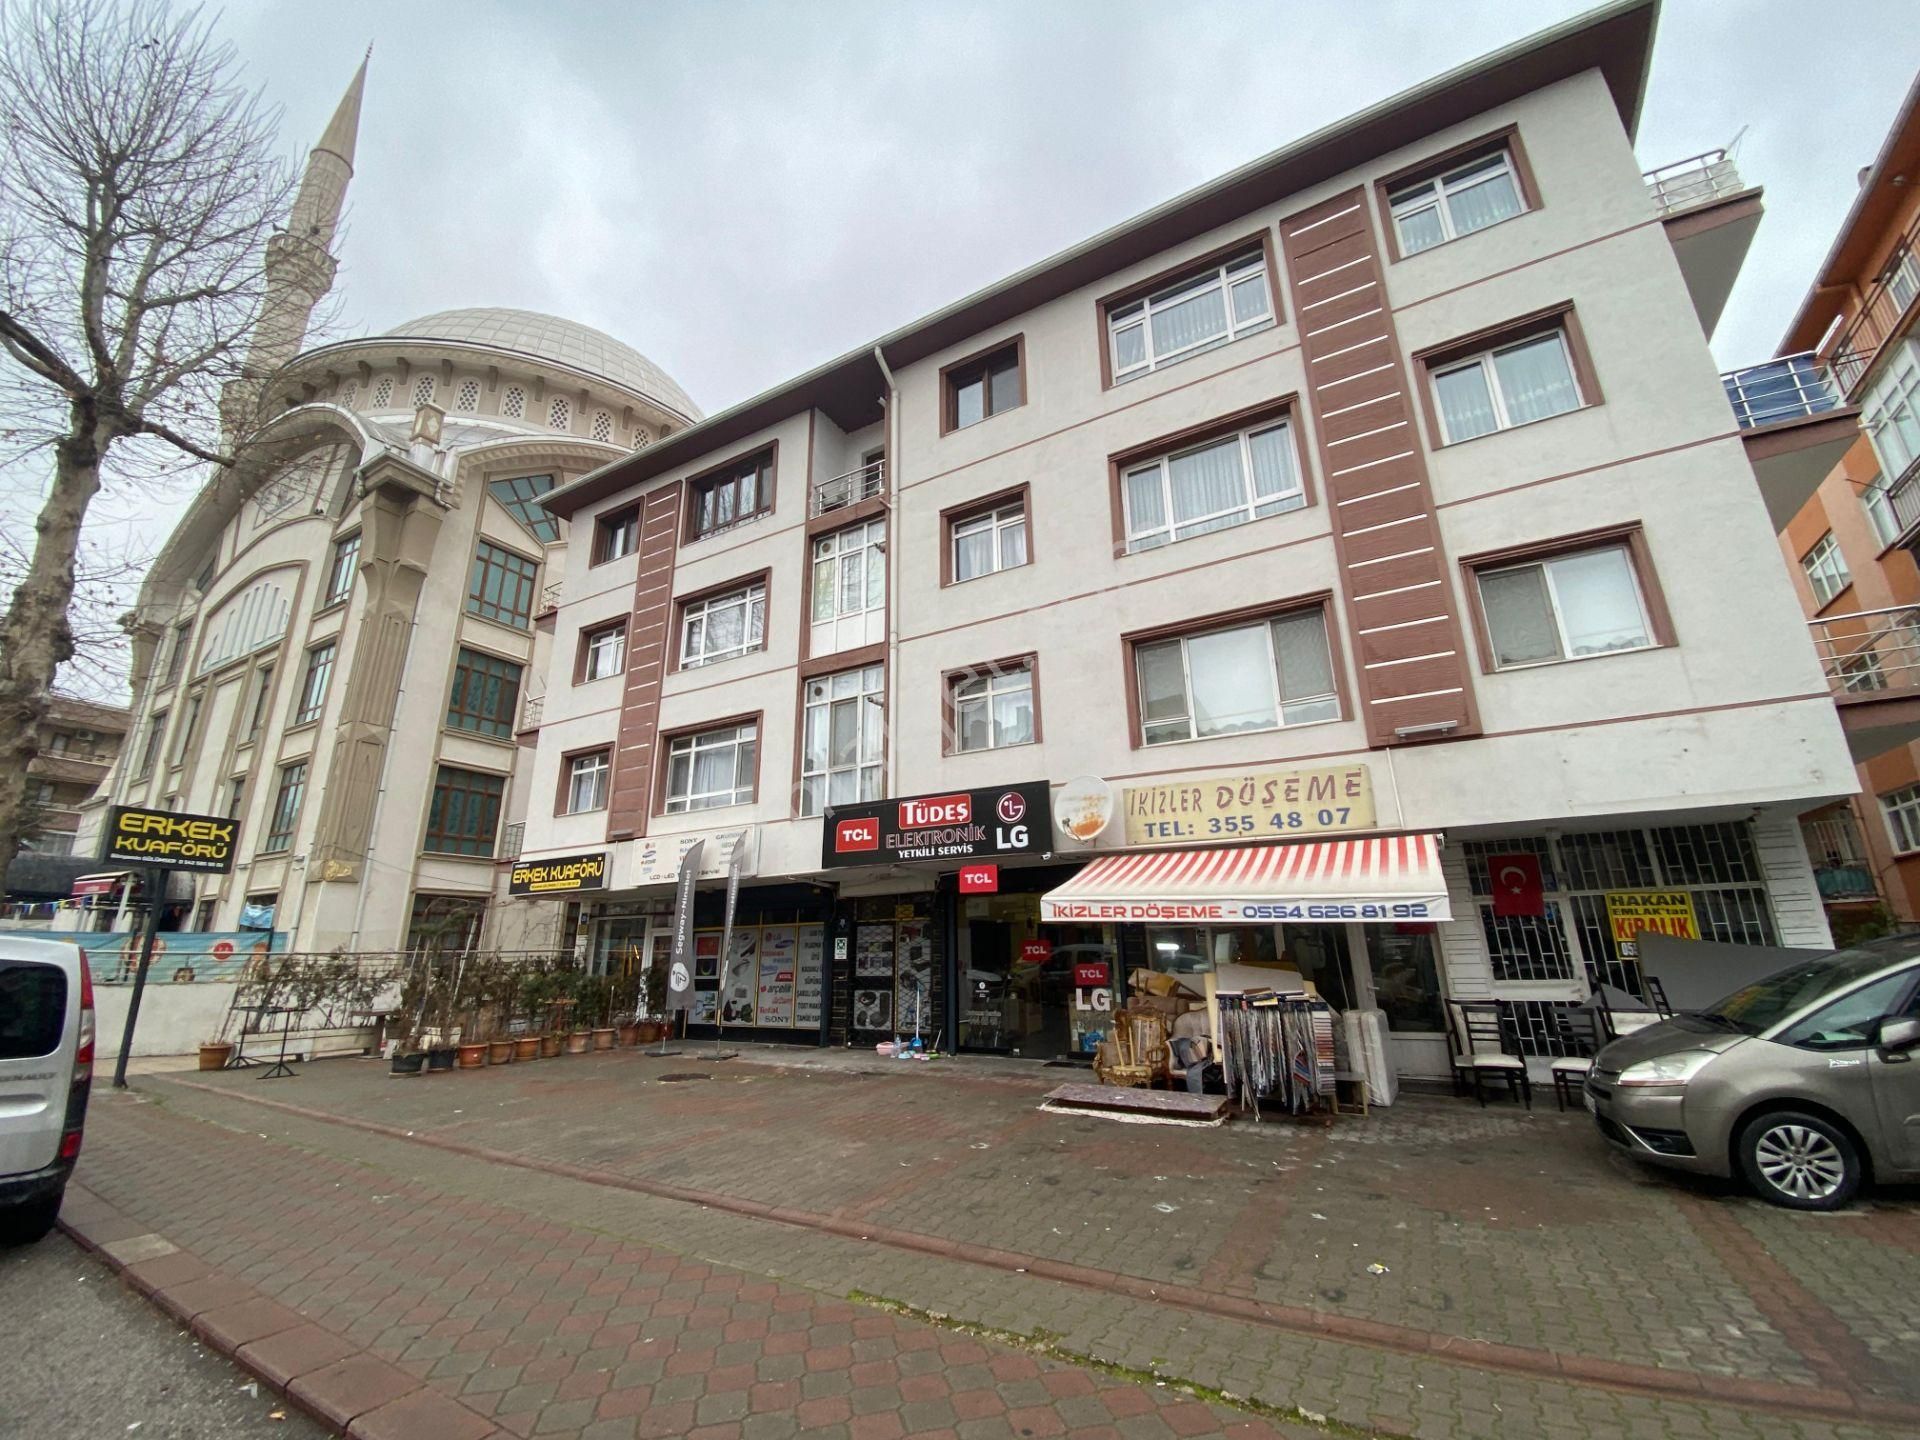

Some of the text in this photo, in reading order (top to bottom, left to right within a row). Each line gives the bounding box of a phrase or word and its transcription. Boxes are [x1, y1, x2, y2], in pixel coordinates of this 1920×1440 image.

[1129, 771, 1362, 817] İKİZLER DÖŞEME
[119, 812, 233, 842] ERKEK
[1144, 807, 1352, 838] TEL: 355 48 07
[842, 828, 873, 842] TCL
[886, 823, 987, 849] ELEKTRONİK
[996, 825, 1029, 850] LG
[115, 836, 228, 859] KUAFÖRÜ
[898, 844, 974, 859] YETKİLİ SERVİS
[512, 856, 604, 884] ERKEK KUAFÖRÜ
[964, 873, 992, 885] TCL
[1053, 903, 1127, 918] İKİZLER
[1131, 903, 1223, 920] DÖŞEME
[1243, 905, 1304, 919] 0554
[1308, 905, 1357, 918] 626
[1361, 904, 1387, 918] 81
[1392, 903, 1429, 918] 92
[1610, 894, 1686, 906] HAKAN
[1025, 945, 1048, 955] TCL
[1079, 969, 1104, 978] TCL
[1075, 988, 1111, 1011] LG
